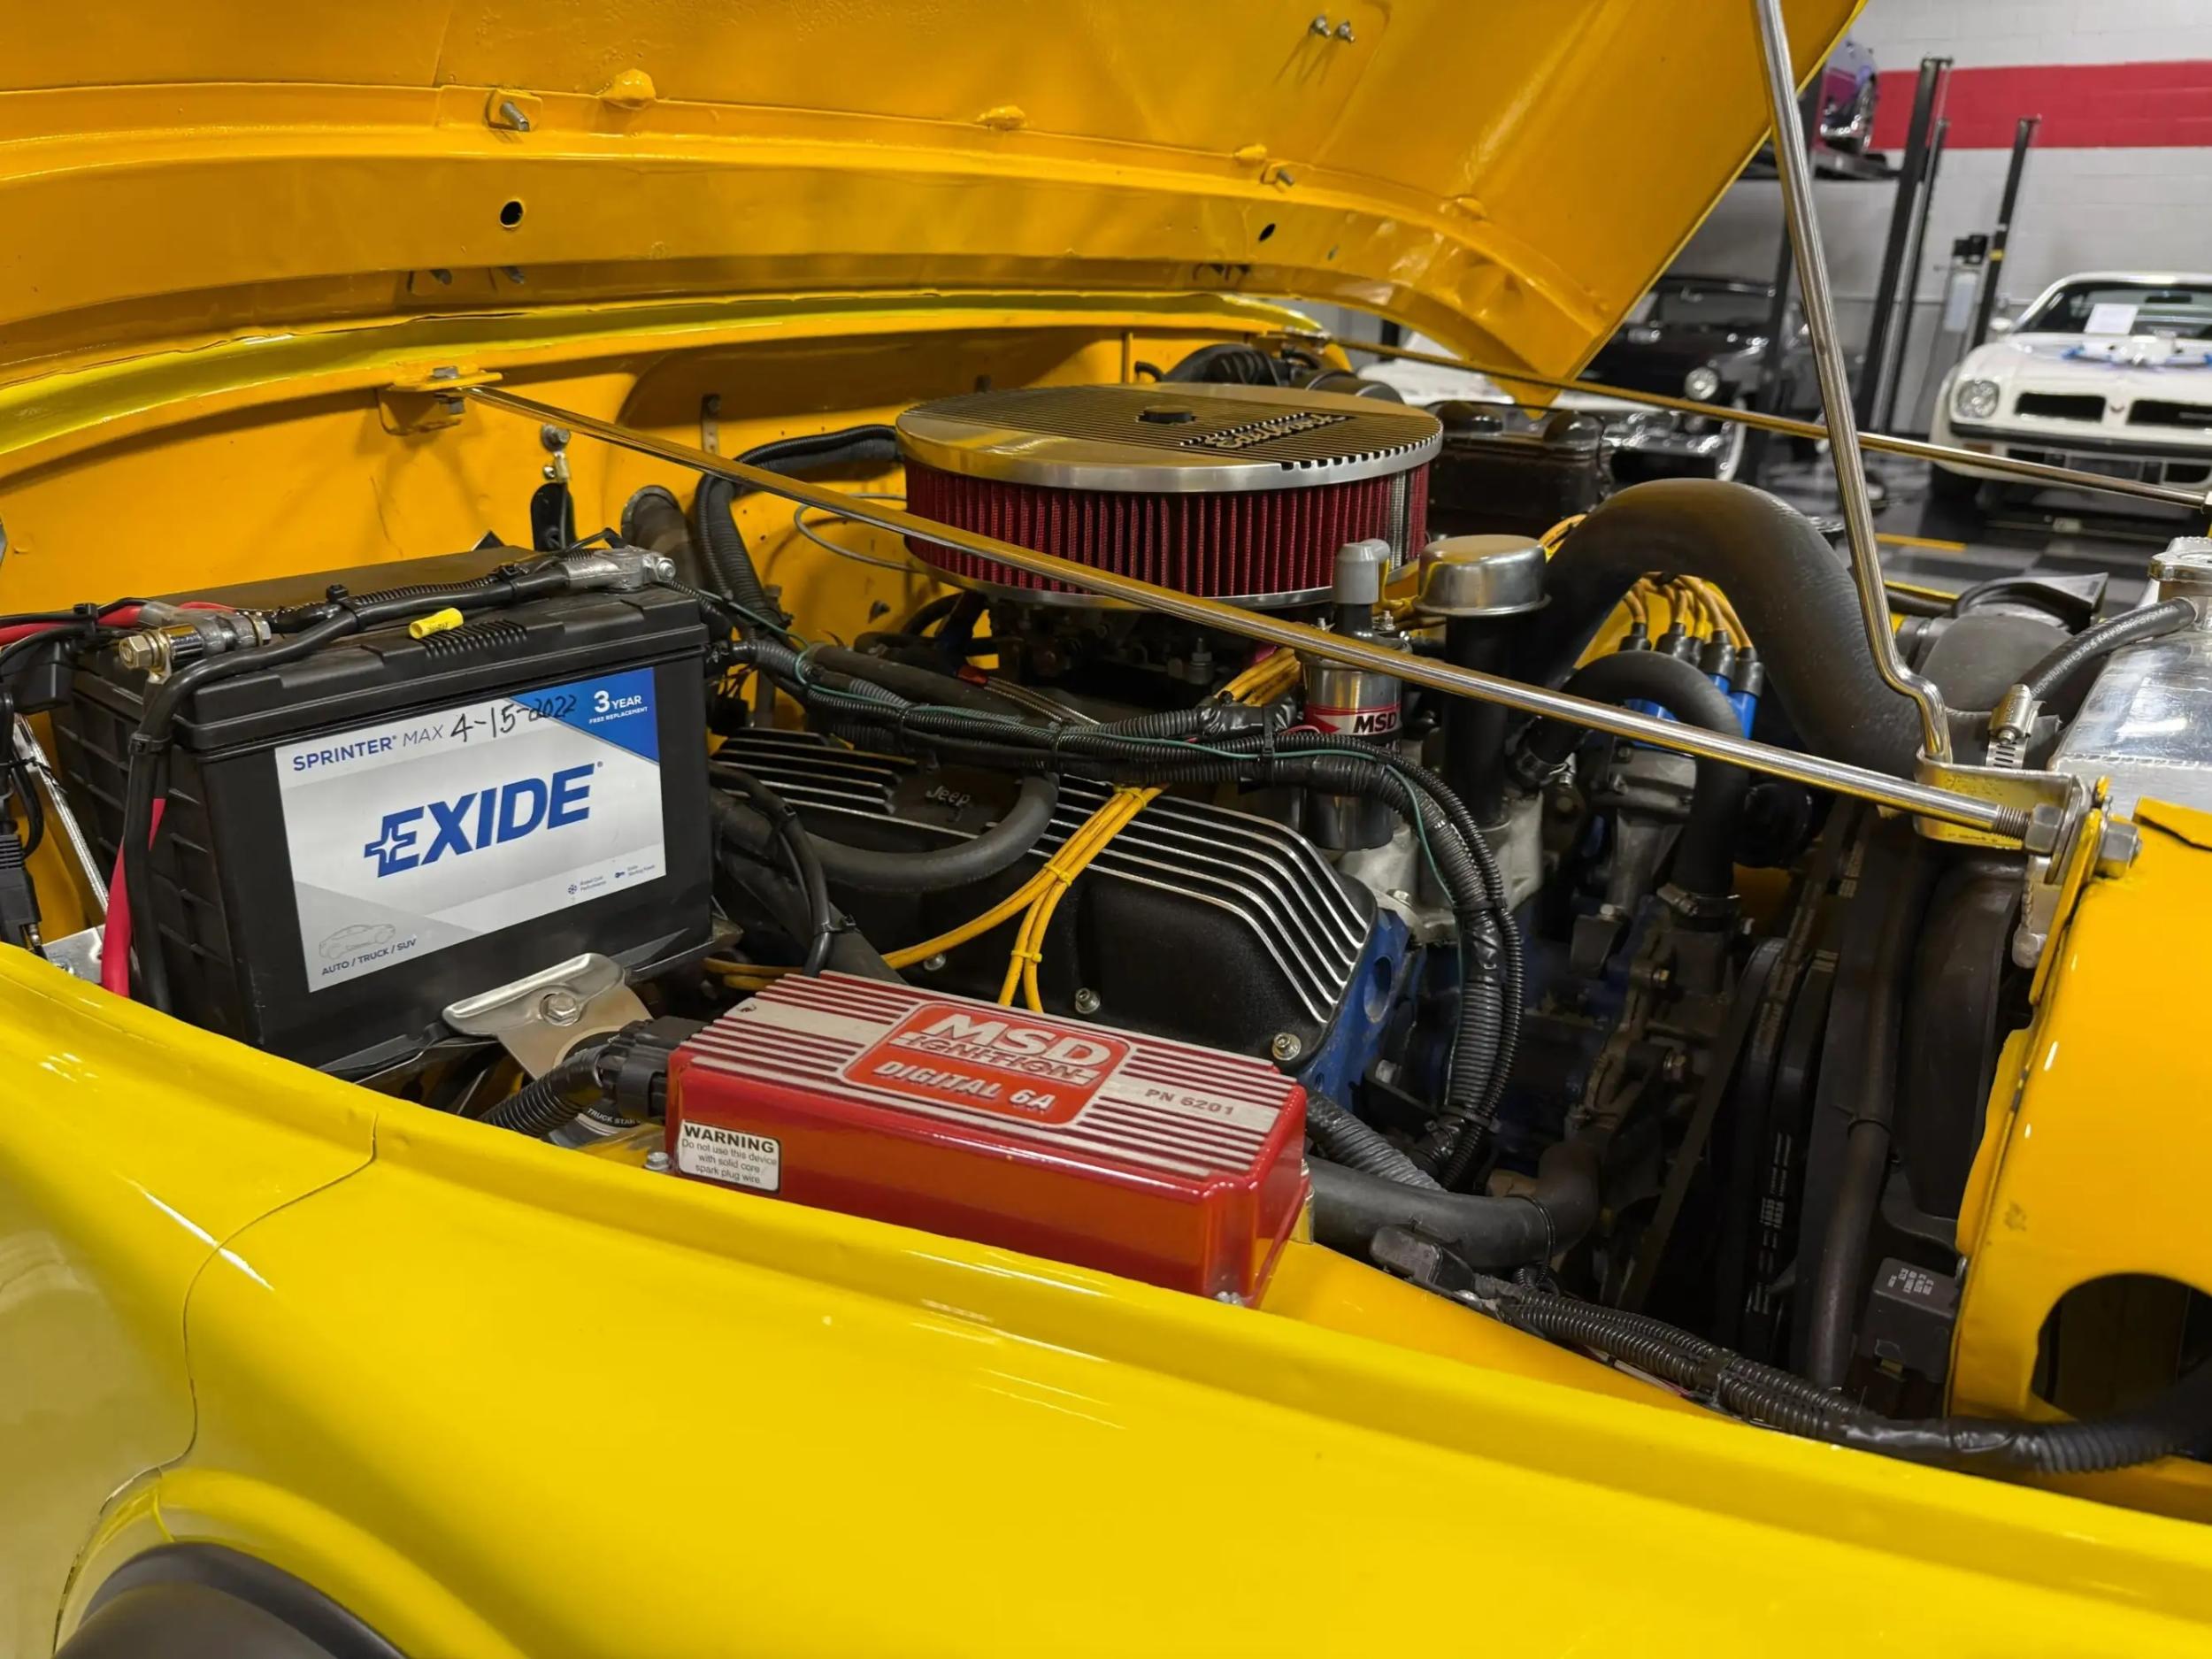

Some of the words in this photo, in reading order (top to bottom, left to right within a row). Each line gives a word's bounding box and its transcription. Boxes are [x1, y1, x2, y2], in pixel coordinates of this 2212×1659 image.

[593, 690, 611, 713] 3
[612, 695, 642, 710] YEAR
[588, 716, 605, 725] FREE
[605, 706, 648, 721] REPLACEMENT
[1353, 711, 1397, 733] MSD
[403, 724, 443, 747] MAX
[926, 786, 971, 806] Jeep
[364, 763, 595, 879] EXIDE
[321, 960, 349, 975] AUTO
[357, 948, 389, 964] TRUCK
[396, 939, 417, 951] SUV
[922, 1013, 1111, 1067] MSD
[908, 1035, 1082, 1079] IGNITION
[872, 1061, 1004, 1099] DIGITAL
[1010, 1089, 1056, 1112] 6A
[1144, 1088, 1175, 1102] PN
[1180, 1097, 1234, 1115] 6201
[587, 1108, 613, 1122] TRUCK
[684, 1124, 774, 1153] WARNING
[681, 1139, 695, 1148] Do
[697, 1142, 710, 1151] not
[712, 1147, 728, 1156] use
[731, 1148, 747, 1159] this
[749, 1153, 777, 1165] device
[698, 1154, 716, 1164] with
[718, 1158, 739, 1169] solid
[741, 1163, 760, 1173] core
[695, 1164, 719, 1175] spark
[721, 1169, 741, 1180] plug
